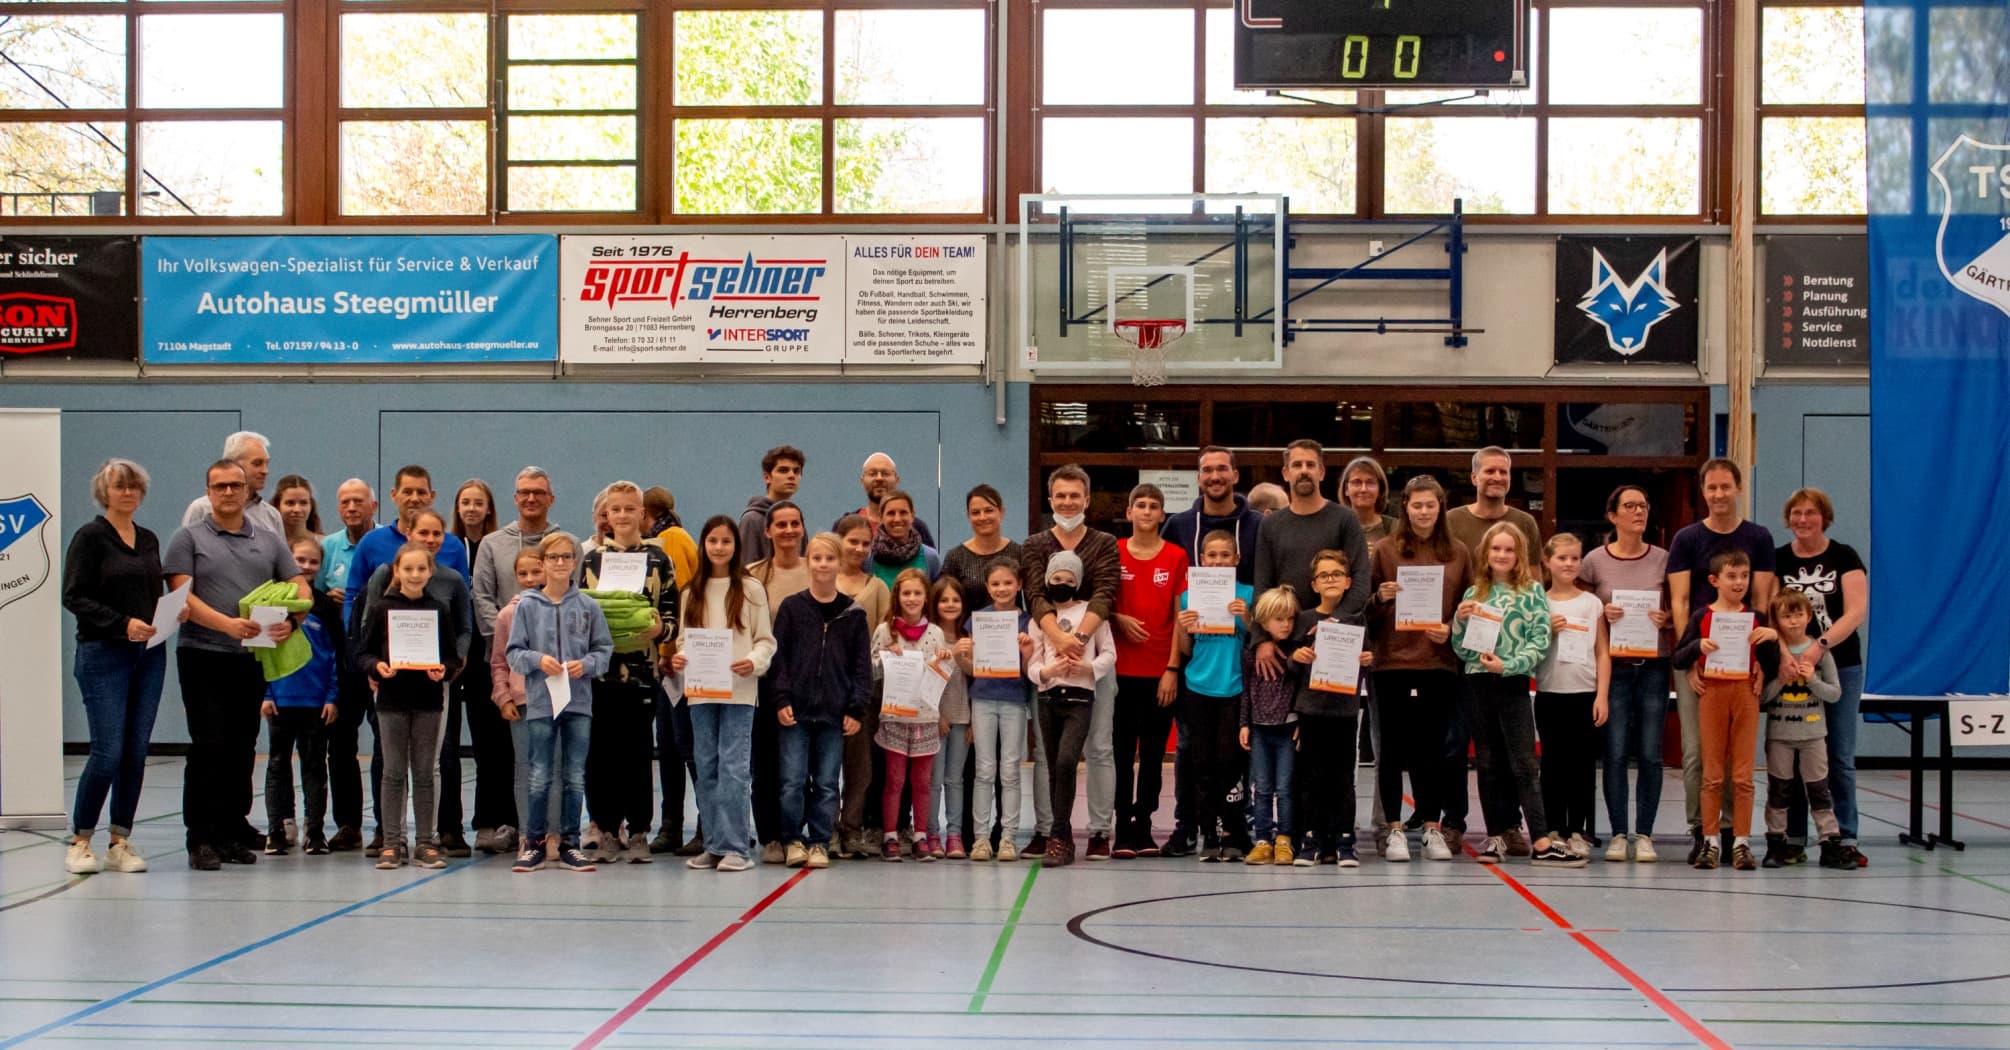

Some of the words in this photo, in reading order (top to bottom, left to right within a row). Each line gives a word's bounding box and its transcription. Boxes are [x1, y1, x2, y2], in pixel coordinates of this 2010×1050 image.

[1342, 35, 1368, 78] 0
[1394, 35, 1421, 78] 0
[19, 248, 78, 265] sicher
[592, 246, 624, 257] Seit
[629, 246, 673, 257] 1976
[854, 247, 887, 258] ALLES
[891, 244, 912, 258] FÜR
[915, 247, 939, 258] DEIN
[943, 247, 975, 258] TEAM!
[158, 258, 179, 273] Ihr
[184, 257, 363, 276] Volkswagen-Spezialist
[369, 258, 391, 272] für
[397, 256, 453, 272] Service
[460, 257, 471, 271] &
[477, 255, 539, 271] Verkauf
[886, 269, 907, 278] nötige
[896, 278, 914, 286] Sport
[1803, 276, 1854, 288] Beratung
[1803, 291, 1848, 303] Planung
[197, 291, 326, 314] Autohaus
[333, 290, 499, 320] Steegmüller
[0, 305, 66, 327] ON
[709, 305, 818, 322] Herrenberg
[888, 309, 919, 317] passende
[920, 309, 973, 317] Sportbekleidung
[1802, 306, 1868, 319] Ausführung
[613, 316, 631, 324] Sport
[659, 323, 696, 332] Herrenberg
[1802, 322, 1843, 332] Service
[723, 328, 810, 342] INTERSPORT
[158, 342, 187, 351] 71106
[189, 342, 232, 353] Magstadt
[392, 340, 539, 351] www.autohaus-steegmueller.eu
[878, 340, 913, 348] passenden
[1802, 338, 1857, 348] Notdienst
